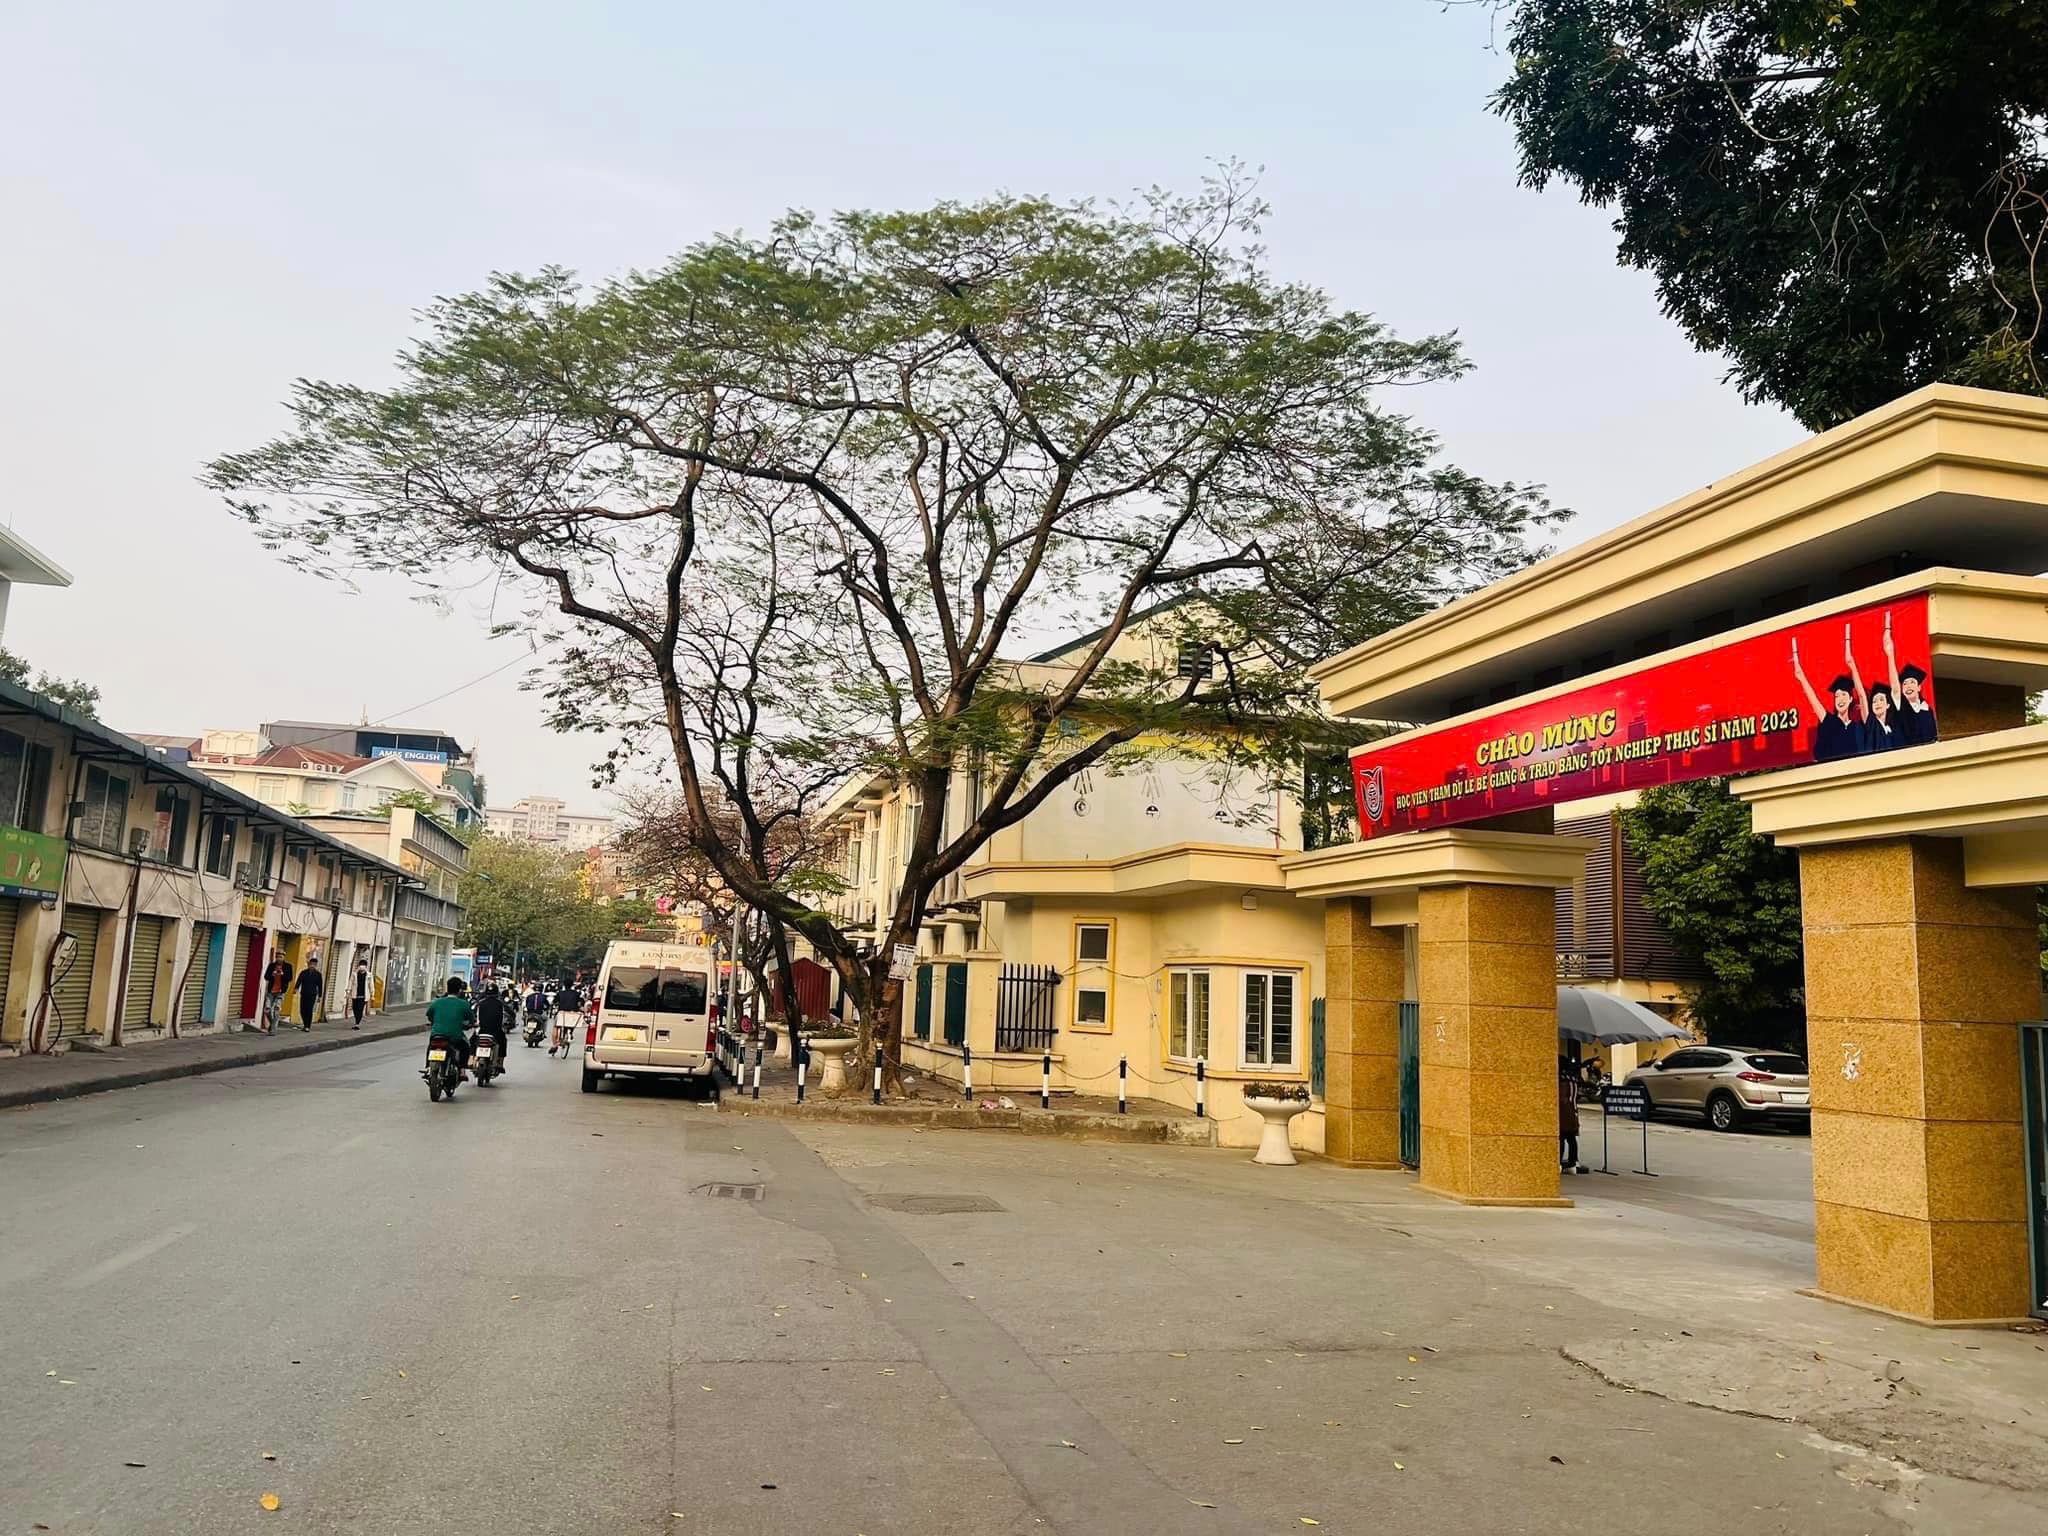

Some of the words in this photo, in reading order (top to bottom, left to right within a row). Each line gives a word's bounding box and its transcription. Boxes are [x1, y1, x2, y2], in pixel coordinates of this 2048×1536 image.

[404, 751, 440, 761] ENGLISH
[1396, 794, 1411, 812] HỌC
[1429, 783, 1451, 802] THAM
[1519, 766, 1527, 782] &
[1529, 760, 1556, 780] TRAO
[1590, 743, 1612, 767] TỐT
[1615, 736, 1662, 760] NGHIỆP
[1664, 728, 1700, 752] THẠC
[1721, 716, 1756, 741] NĂM
[1761, 708, 1798, 733] 2023
[1476, 730, 1535, 766] CHÀO
[1541, 708, 1617, 751] MỪNG
